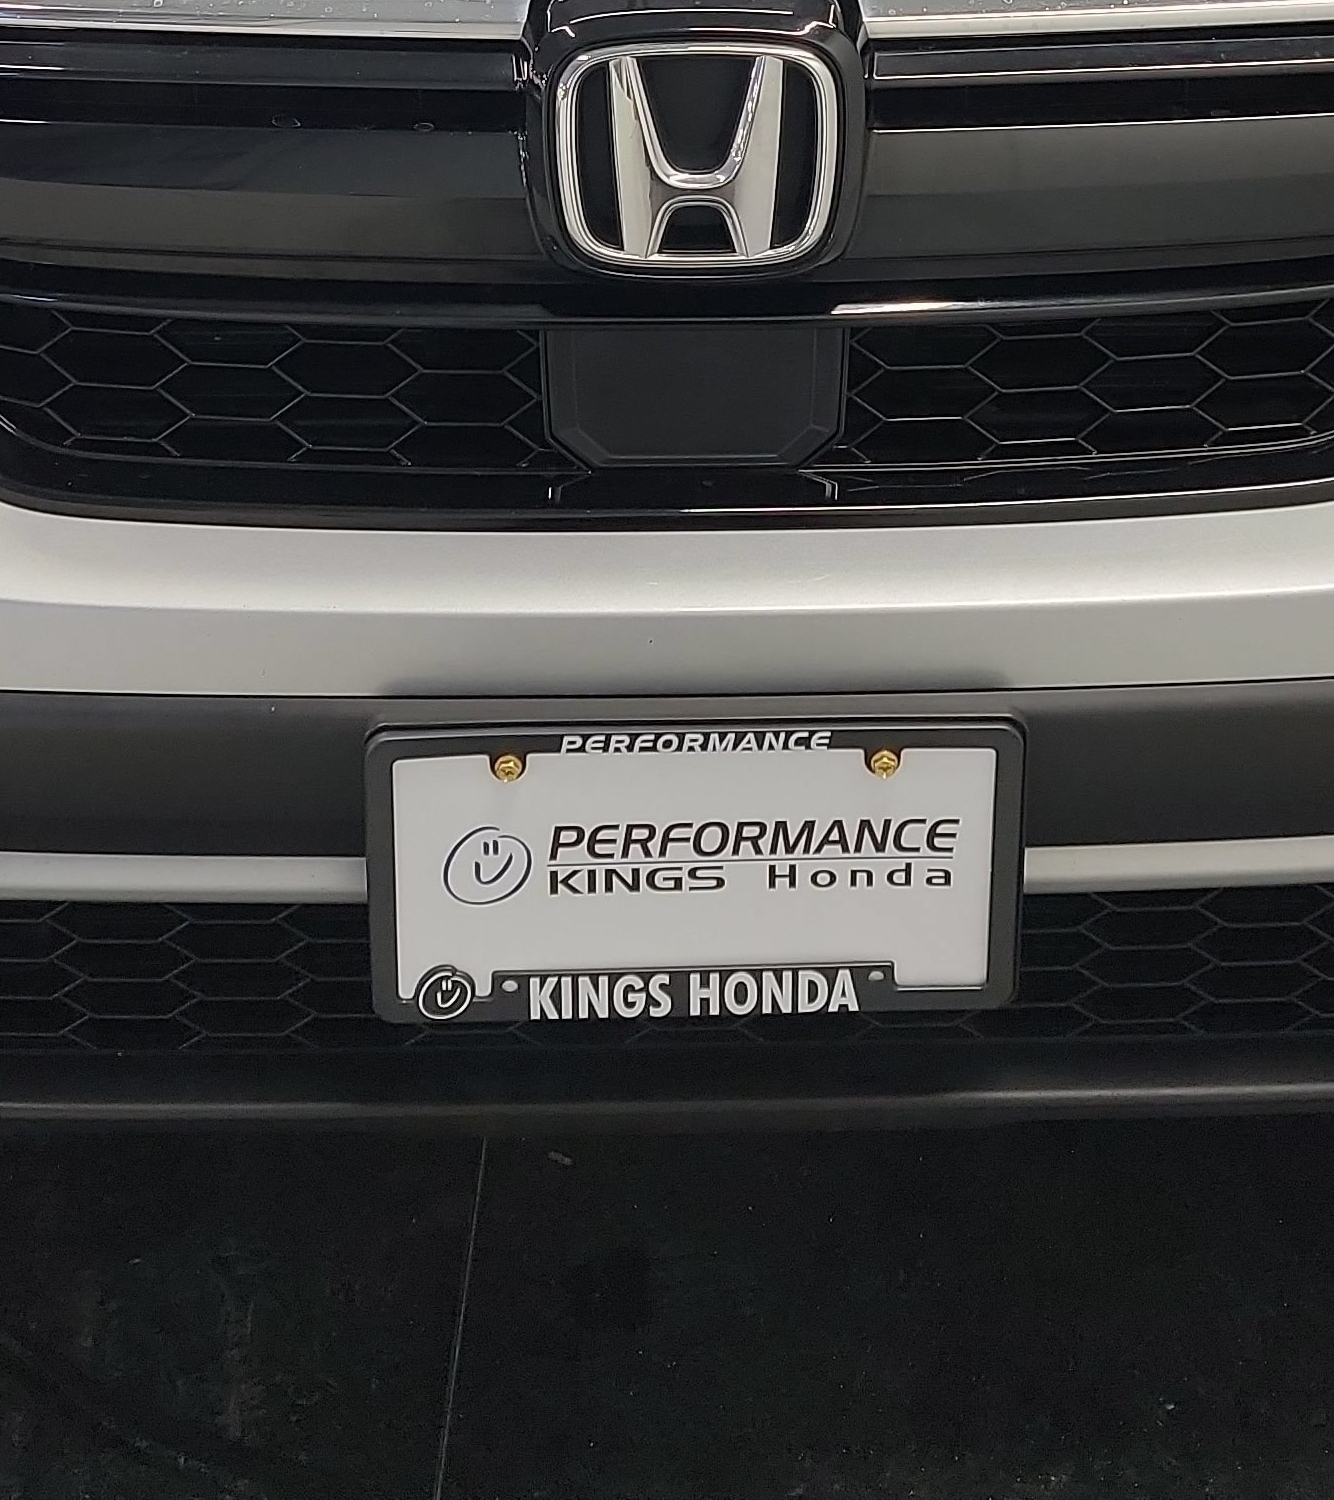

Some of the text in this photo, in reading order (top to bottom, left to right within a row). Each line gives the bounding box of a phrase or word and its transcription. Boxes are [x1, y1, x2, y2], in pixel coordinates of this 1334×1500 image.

[560, 731, 832, 755] PERFORMANCE
[548, 818, 960, 861] PERFORMANCE
[549, 862, 952, 895] KINGS Honda
[529, 969, 860, 1021] KINGS HONDA
